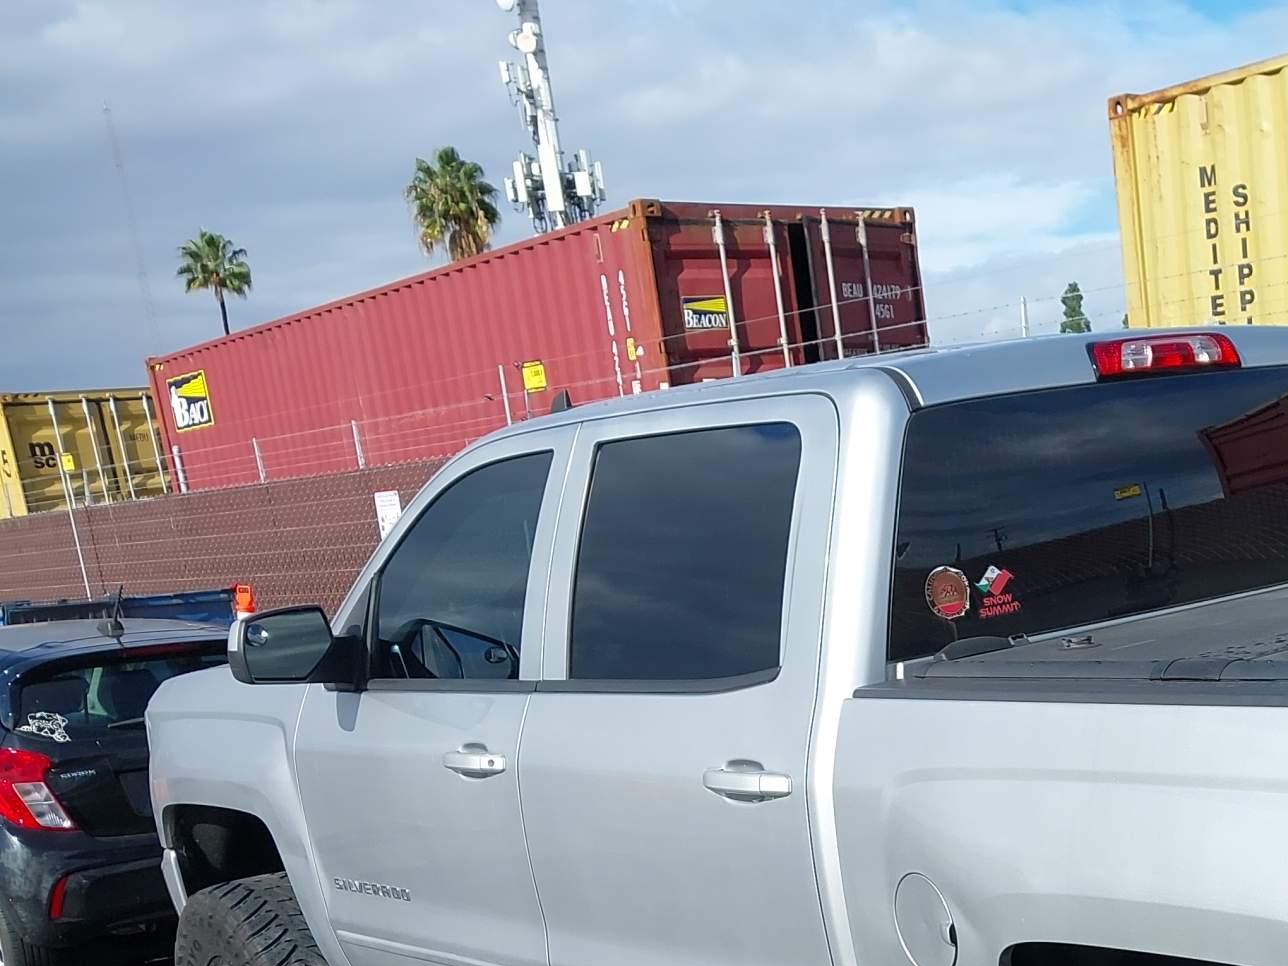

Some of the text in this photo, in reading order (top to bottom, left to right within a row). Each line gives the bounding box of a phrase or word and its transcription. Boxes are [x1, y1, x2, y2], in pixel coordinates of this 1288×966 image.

[1199, 164, 1226, 325] MEDITE
[684, 309, 727, 328] BEACON
[983, 593, 1013, 606] SNOW
[333, 878, 412, 902] SILVERADO
